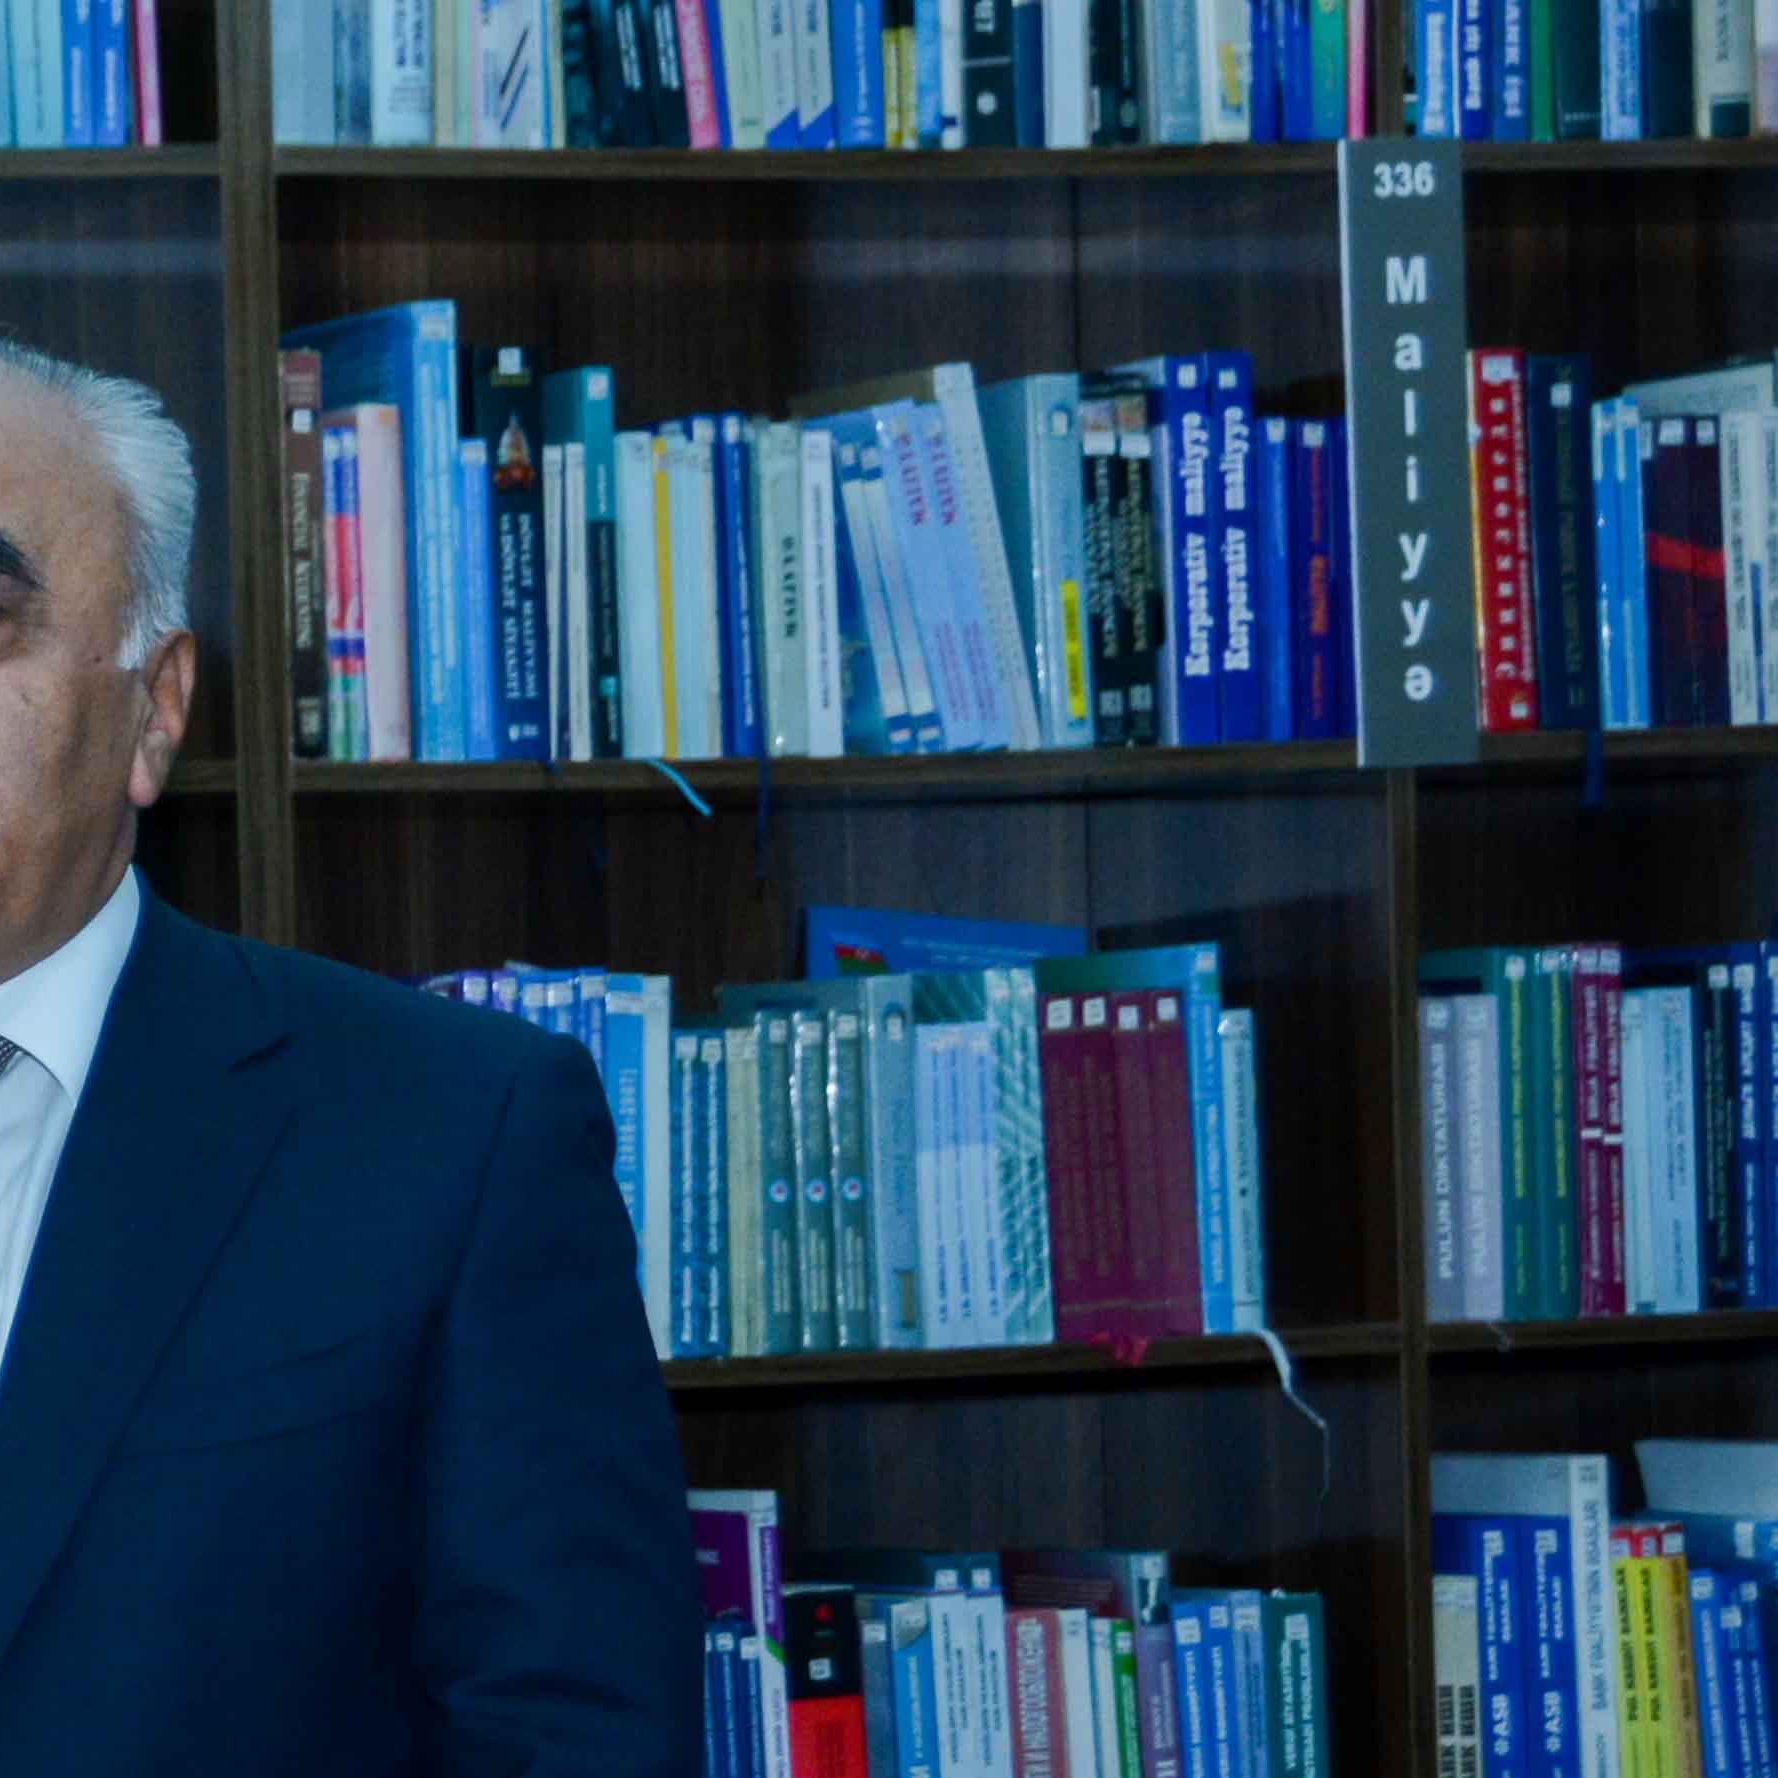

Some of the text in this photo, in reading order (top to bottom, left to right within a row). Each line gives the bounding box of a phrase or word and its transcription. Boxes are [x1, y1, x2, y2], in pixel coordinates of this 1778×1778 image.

[1372, 162, 1434, 198] 336
[1491, 1694, 1511, 1737] ASB
[1543, 1691, 1563, 1734] ASB
